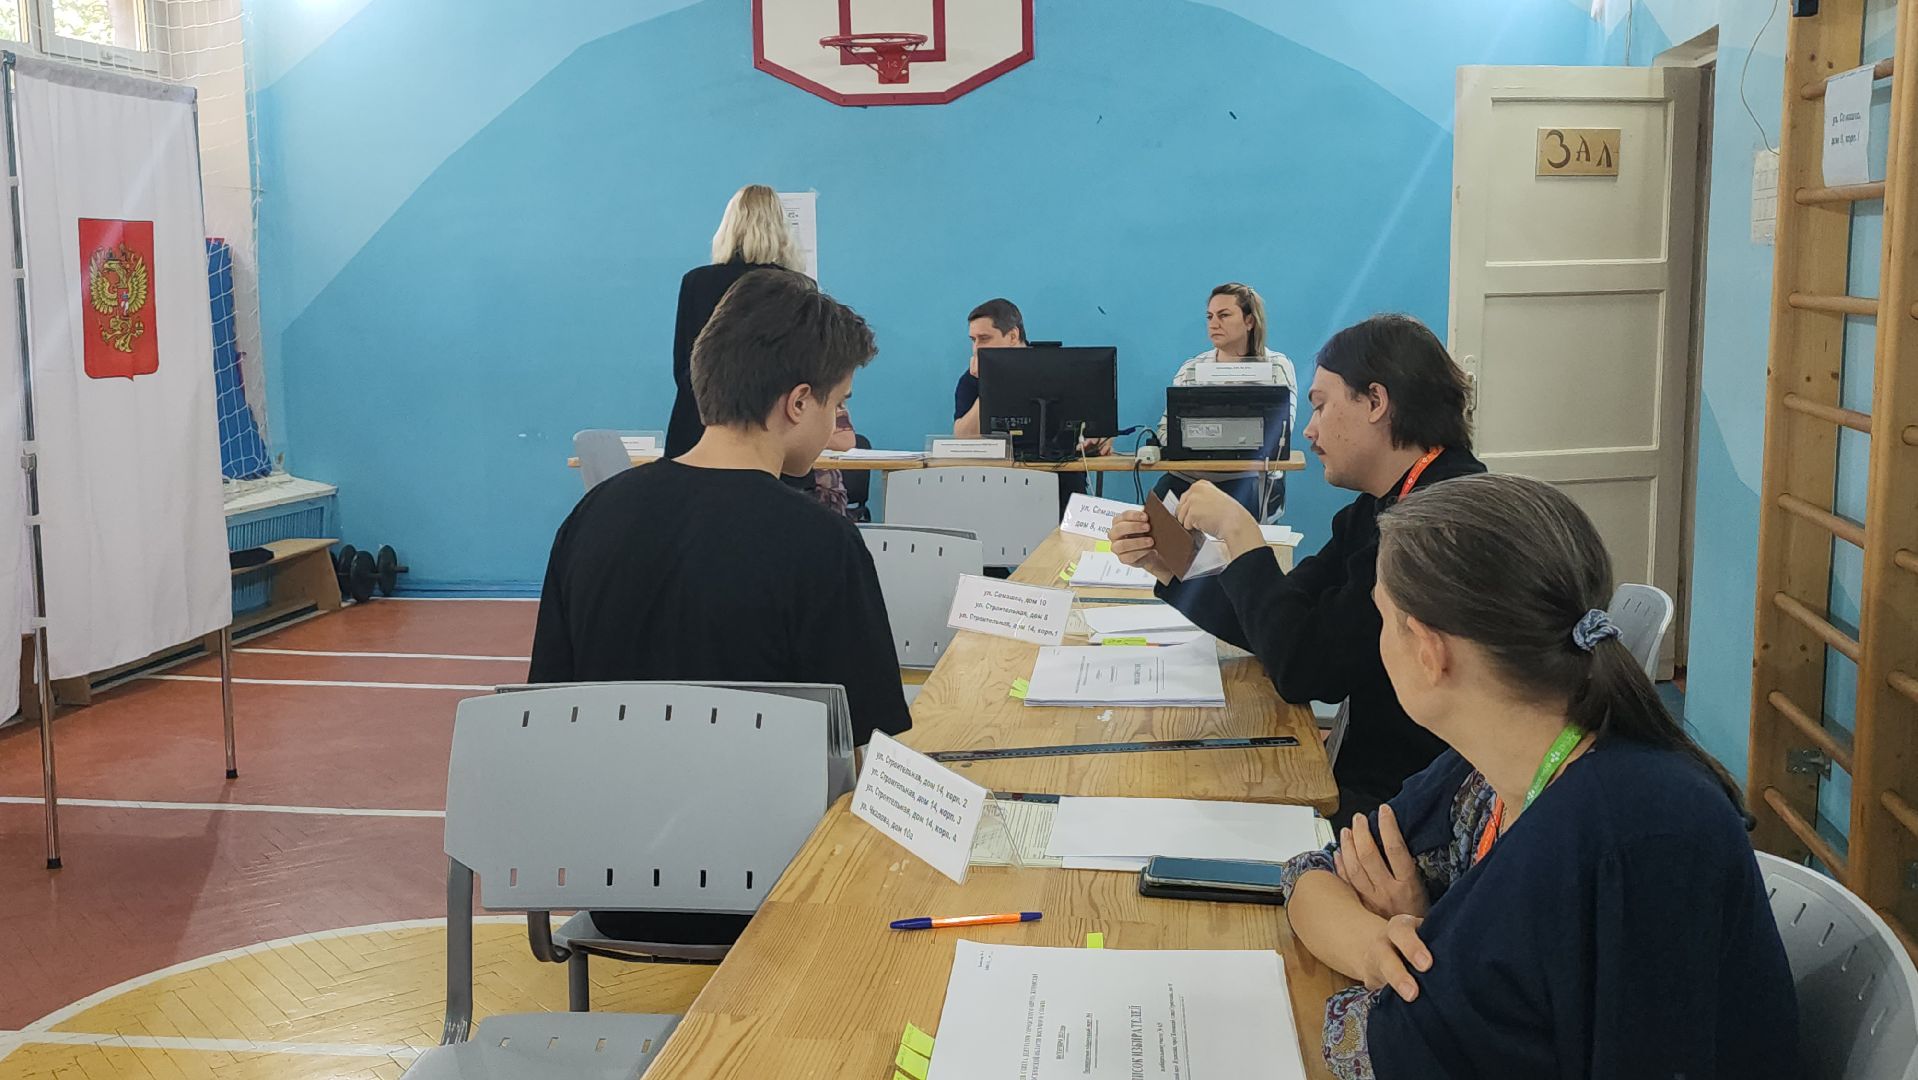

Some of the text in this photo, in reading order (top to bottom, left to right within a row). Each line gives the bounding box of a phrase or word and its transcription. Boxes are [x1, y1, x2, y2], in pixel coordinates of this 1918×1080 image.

[1545, 129, 1612, 169] ЗАЛ
[1080, 504, 1090, 513] ул.
[1074, 520, 1088, 528] дом
[1098, 526, 1111, 534] кор
[985, 602, 1029, 618] Строительная,
[1029, 612, 1042, 620] дом
[1024, 597, 1038, 605] дом
[1039, 597, 1047, 607] 10
[969, 613, 1012, 628] Строительная,
[1027, 624, 1036, 634] 14,
[870, 767, 963, 825] ул. Строительная, дом 14, корп. 3
[875, 751, 969, 809] ул. Строительная, дом 14, корп. 2
[859, 801, 867, 811] ул.
[890, 822, 902, 833] дом
[865, 783, 957, 843] ул. Строительная, дом 14, корп. 4
[1128, 1005, 1143, 1057] ИЗБИРАТЕЛЕЙ
